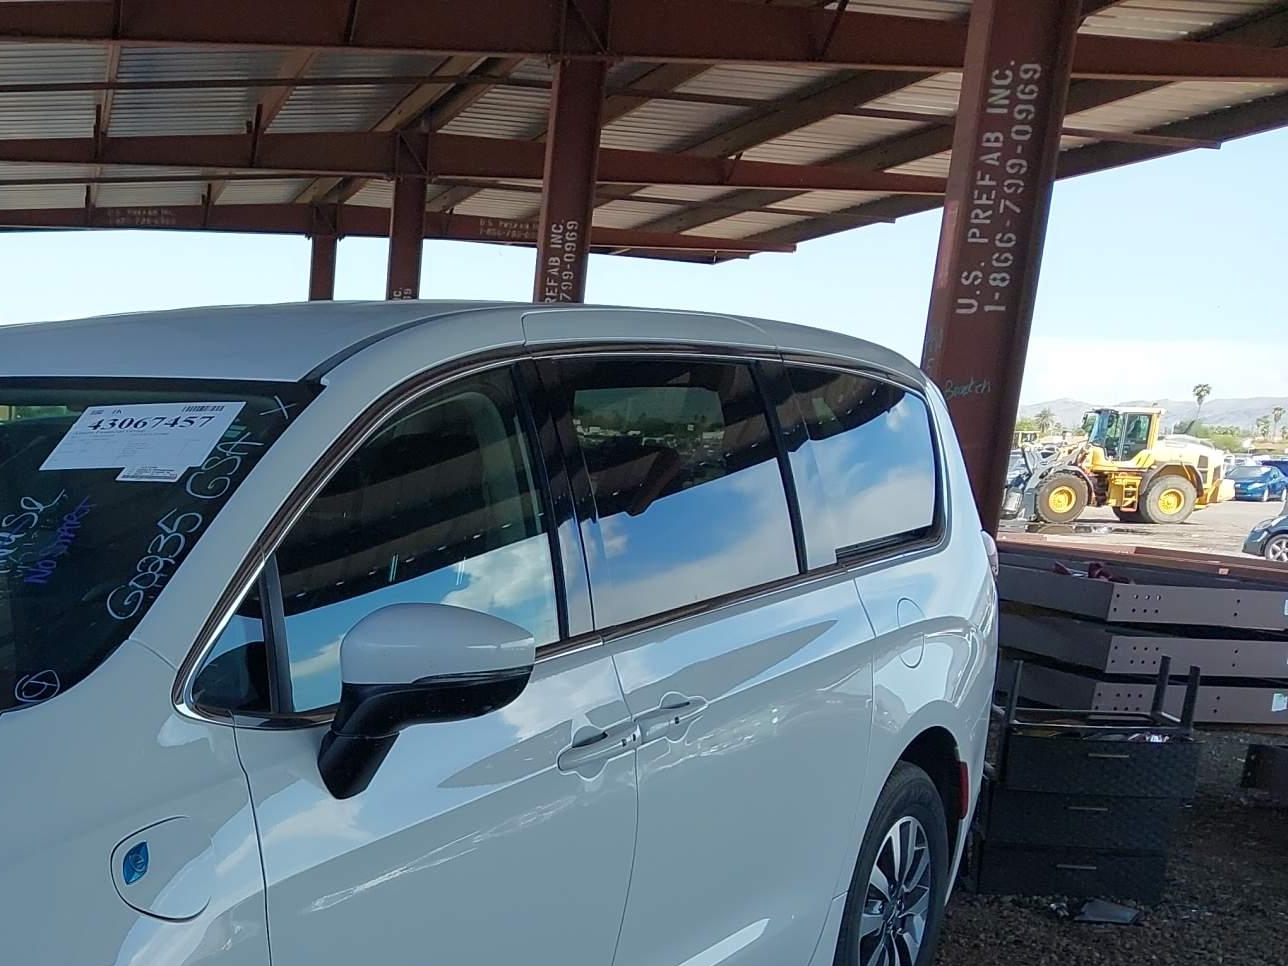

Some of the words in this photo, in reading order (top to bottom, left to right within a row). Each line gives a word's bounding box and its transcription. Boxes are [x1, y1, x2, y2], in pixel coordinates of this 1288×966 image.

[986, 60, 1015, 114] INC.
[968, 131, 1004, 243] PREFAB
[984, 63, 1042, 312] 1-866-799-0969
[550, 219, 565, 249] INC.
[956, 262, 985, 314] U.S.
[88, 415, 216, 431] 43067457
[185, 431, 264, 499] GSA
